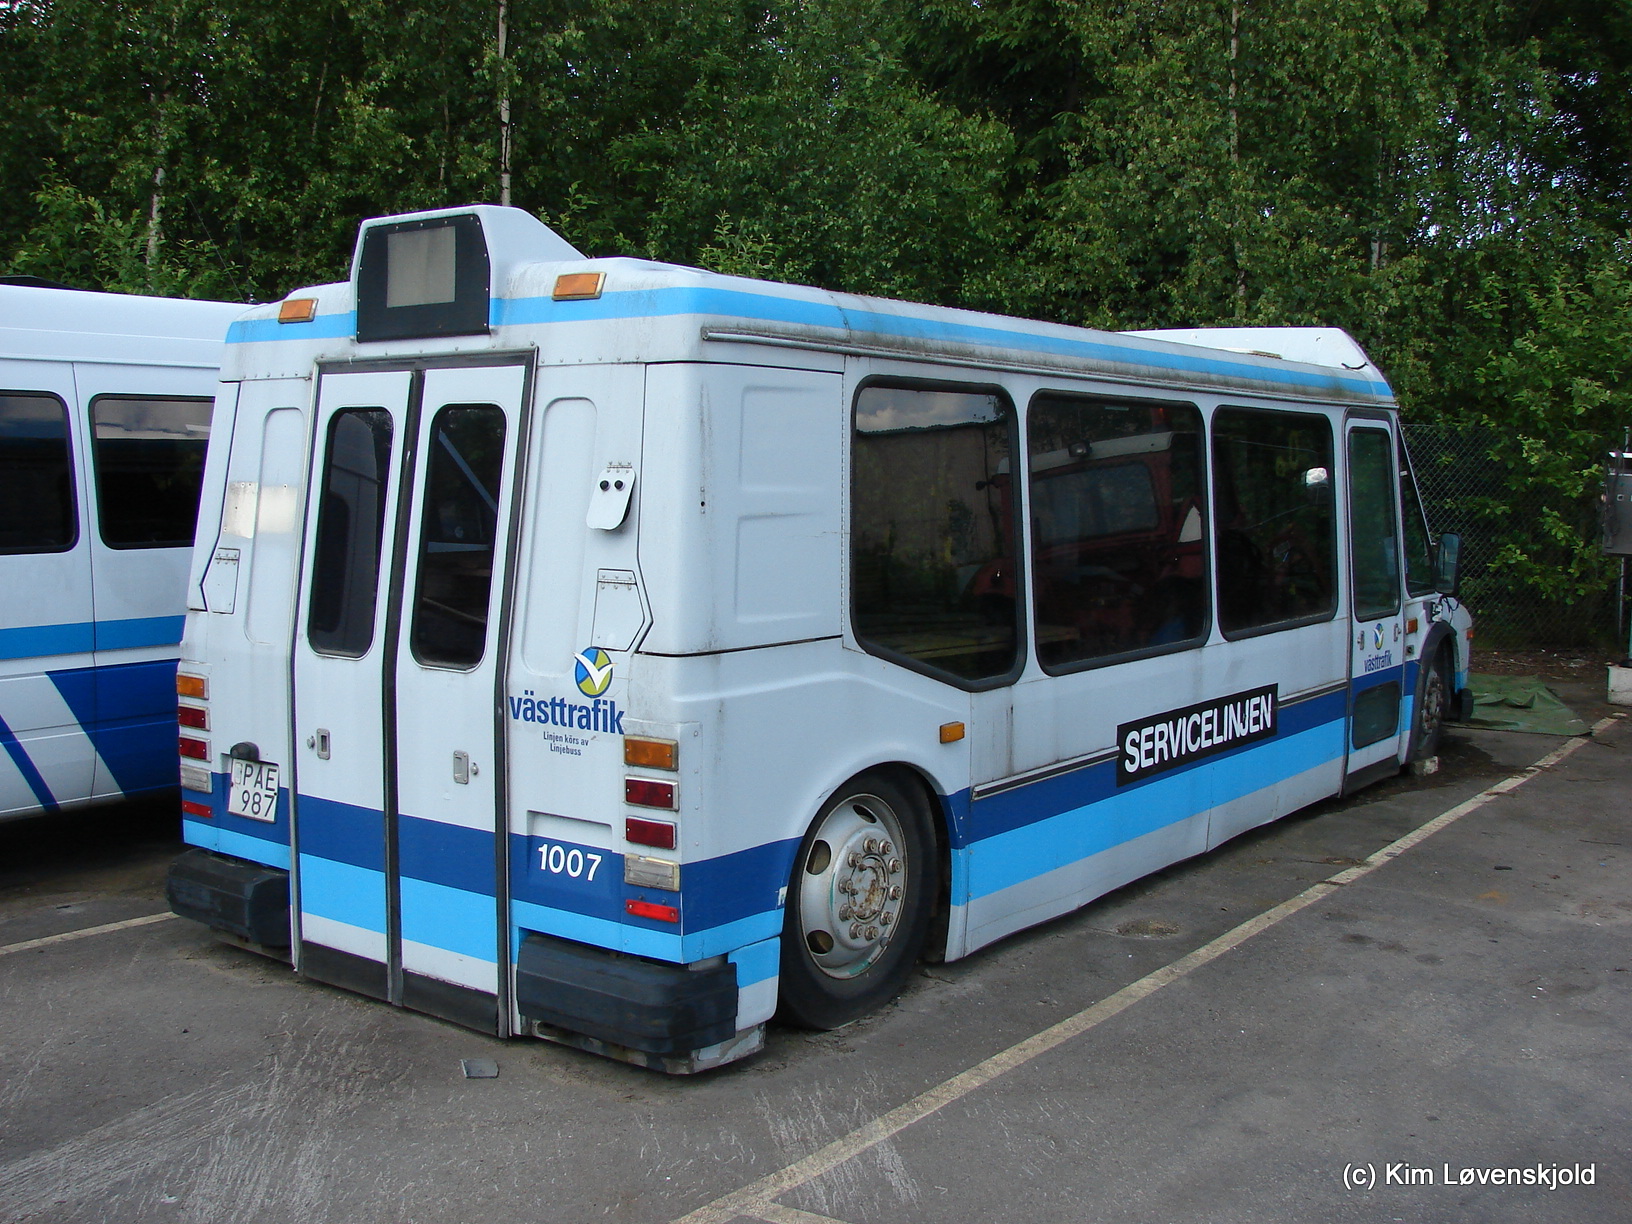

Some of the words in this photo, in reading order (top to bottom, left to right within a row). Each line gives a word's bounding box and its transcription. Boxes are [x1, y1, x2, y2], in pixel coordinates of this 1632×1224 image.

[1364, 650, 1392, 672] västtrafik
[509, 690, 625, 735] västtrafik
[543, 730, 563, 744] Linjen
[564, 733, 579, 744] körs
[581, 737, 590, 747] av
[1124, 693, 1272, 773] SERVICELINJEN
[550, 743, 581, 756] Linjebuss
[243, 763, 277, 791] PAE
[242, 790, 275, 817] 987
[537, 843, 602, 881] 1007
